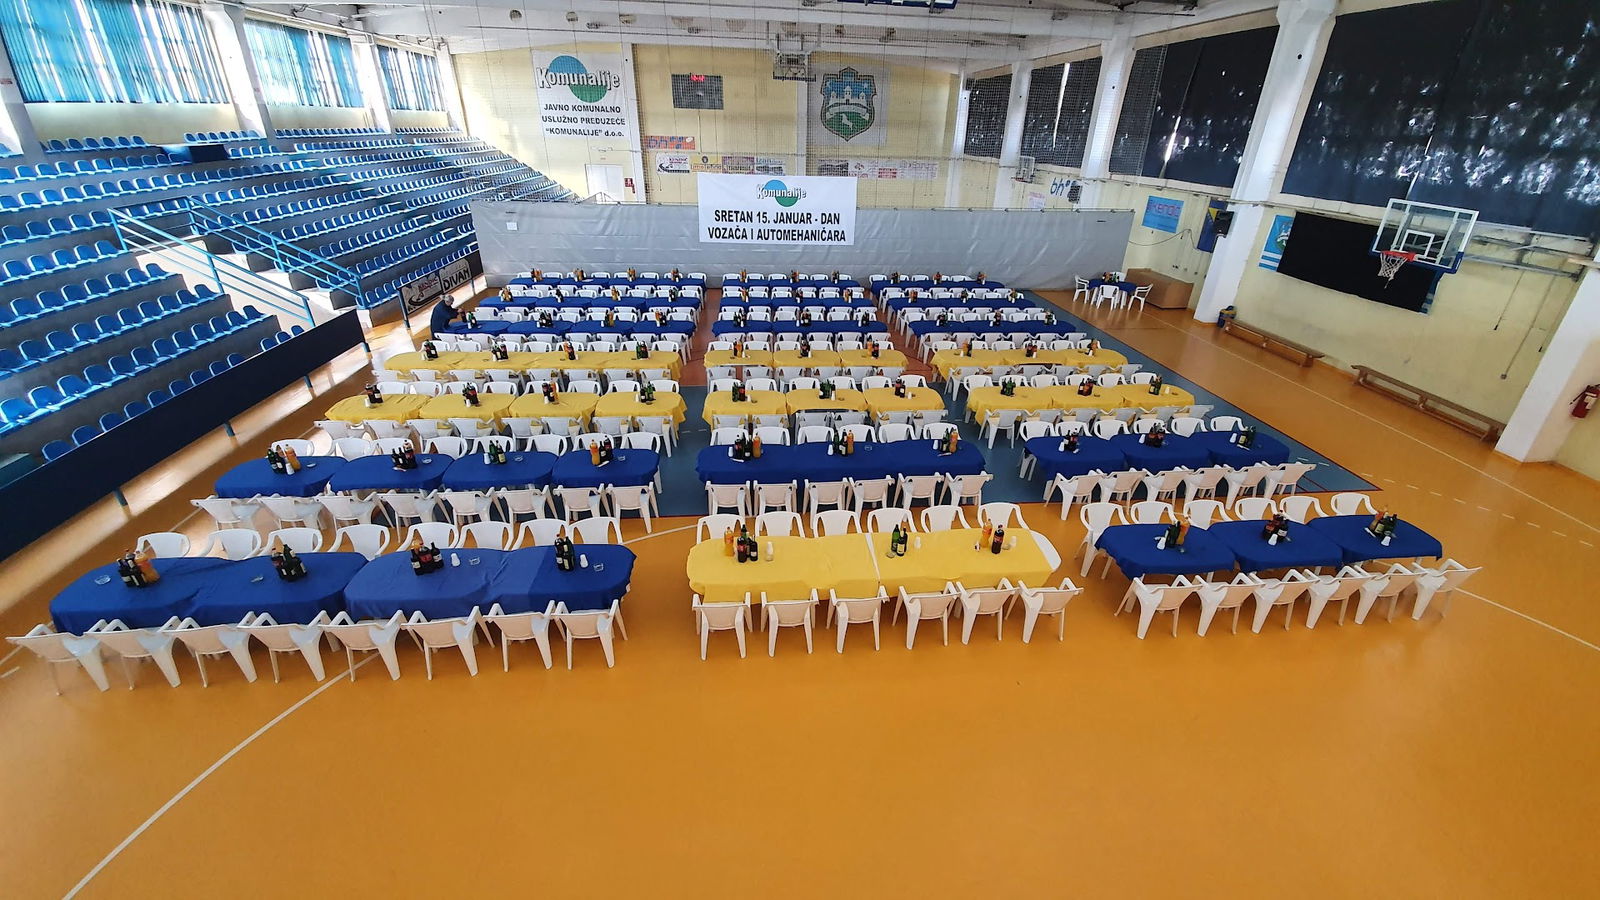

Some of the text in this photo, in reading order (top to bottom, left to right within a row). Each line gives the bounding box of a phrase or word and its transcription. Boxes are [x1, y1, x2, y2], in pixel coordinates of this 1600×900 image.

[536, 67, 621, 91] Komunalije
[543, 103, 621, 114] JAVNO KOMUNALNO
[541, 114, 579, 124] USLUŽNO
[604, 129, 625, 137] d.o.o.
[755, 184, 807, 200] Komunalije
[714, 209, 754, 224] SRETAN
[756, 211, 771, 225] 15.
[773, 211, 813, 225] JANUAR
[820, 212, 841, 225] DAN
[708, 225, 748, 240] VOZAČA
[750, 228, 754, 240] I
